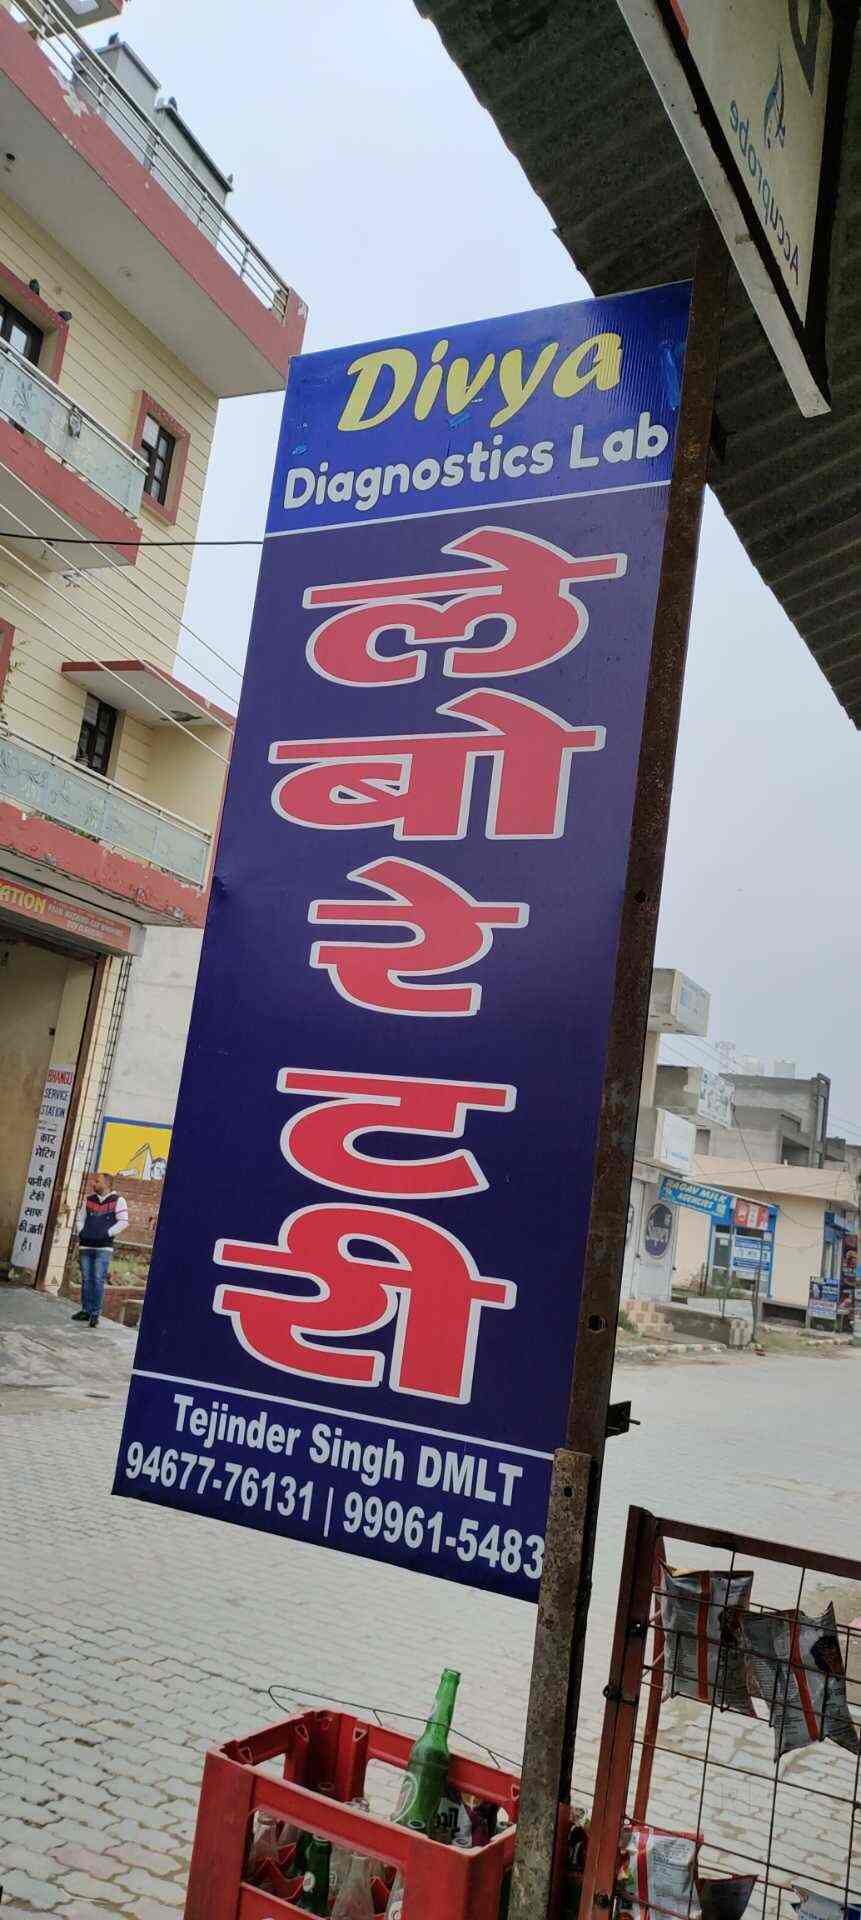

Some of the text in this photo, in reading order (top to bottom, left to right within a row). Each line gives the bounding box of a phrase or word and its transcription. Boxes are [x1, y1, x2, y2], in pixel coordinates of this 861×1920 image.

[337, 332, 623, 432] Divya
[283, 412, 669, 511] Diagnostics Lab
[40, 1105, 65, 1118] STATION
[43, 1087, 69, 1101] SERVICE
[173, 1393, 524, 1507] Tejinder Singh DMLT
[125, 1441, 314, 1522] 94677-76131
[342, 1491, 545, 1580] 99961-5483
